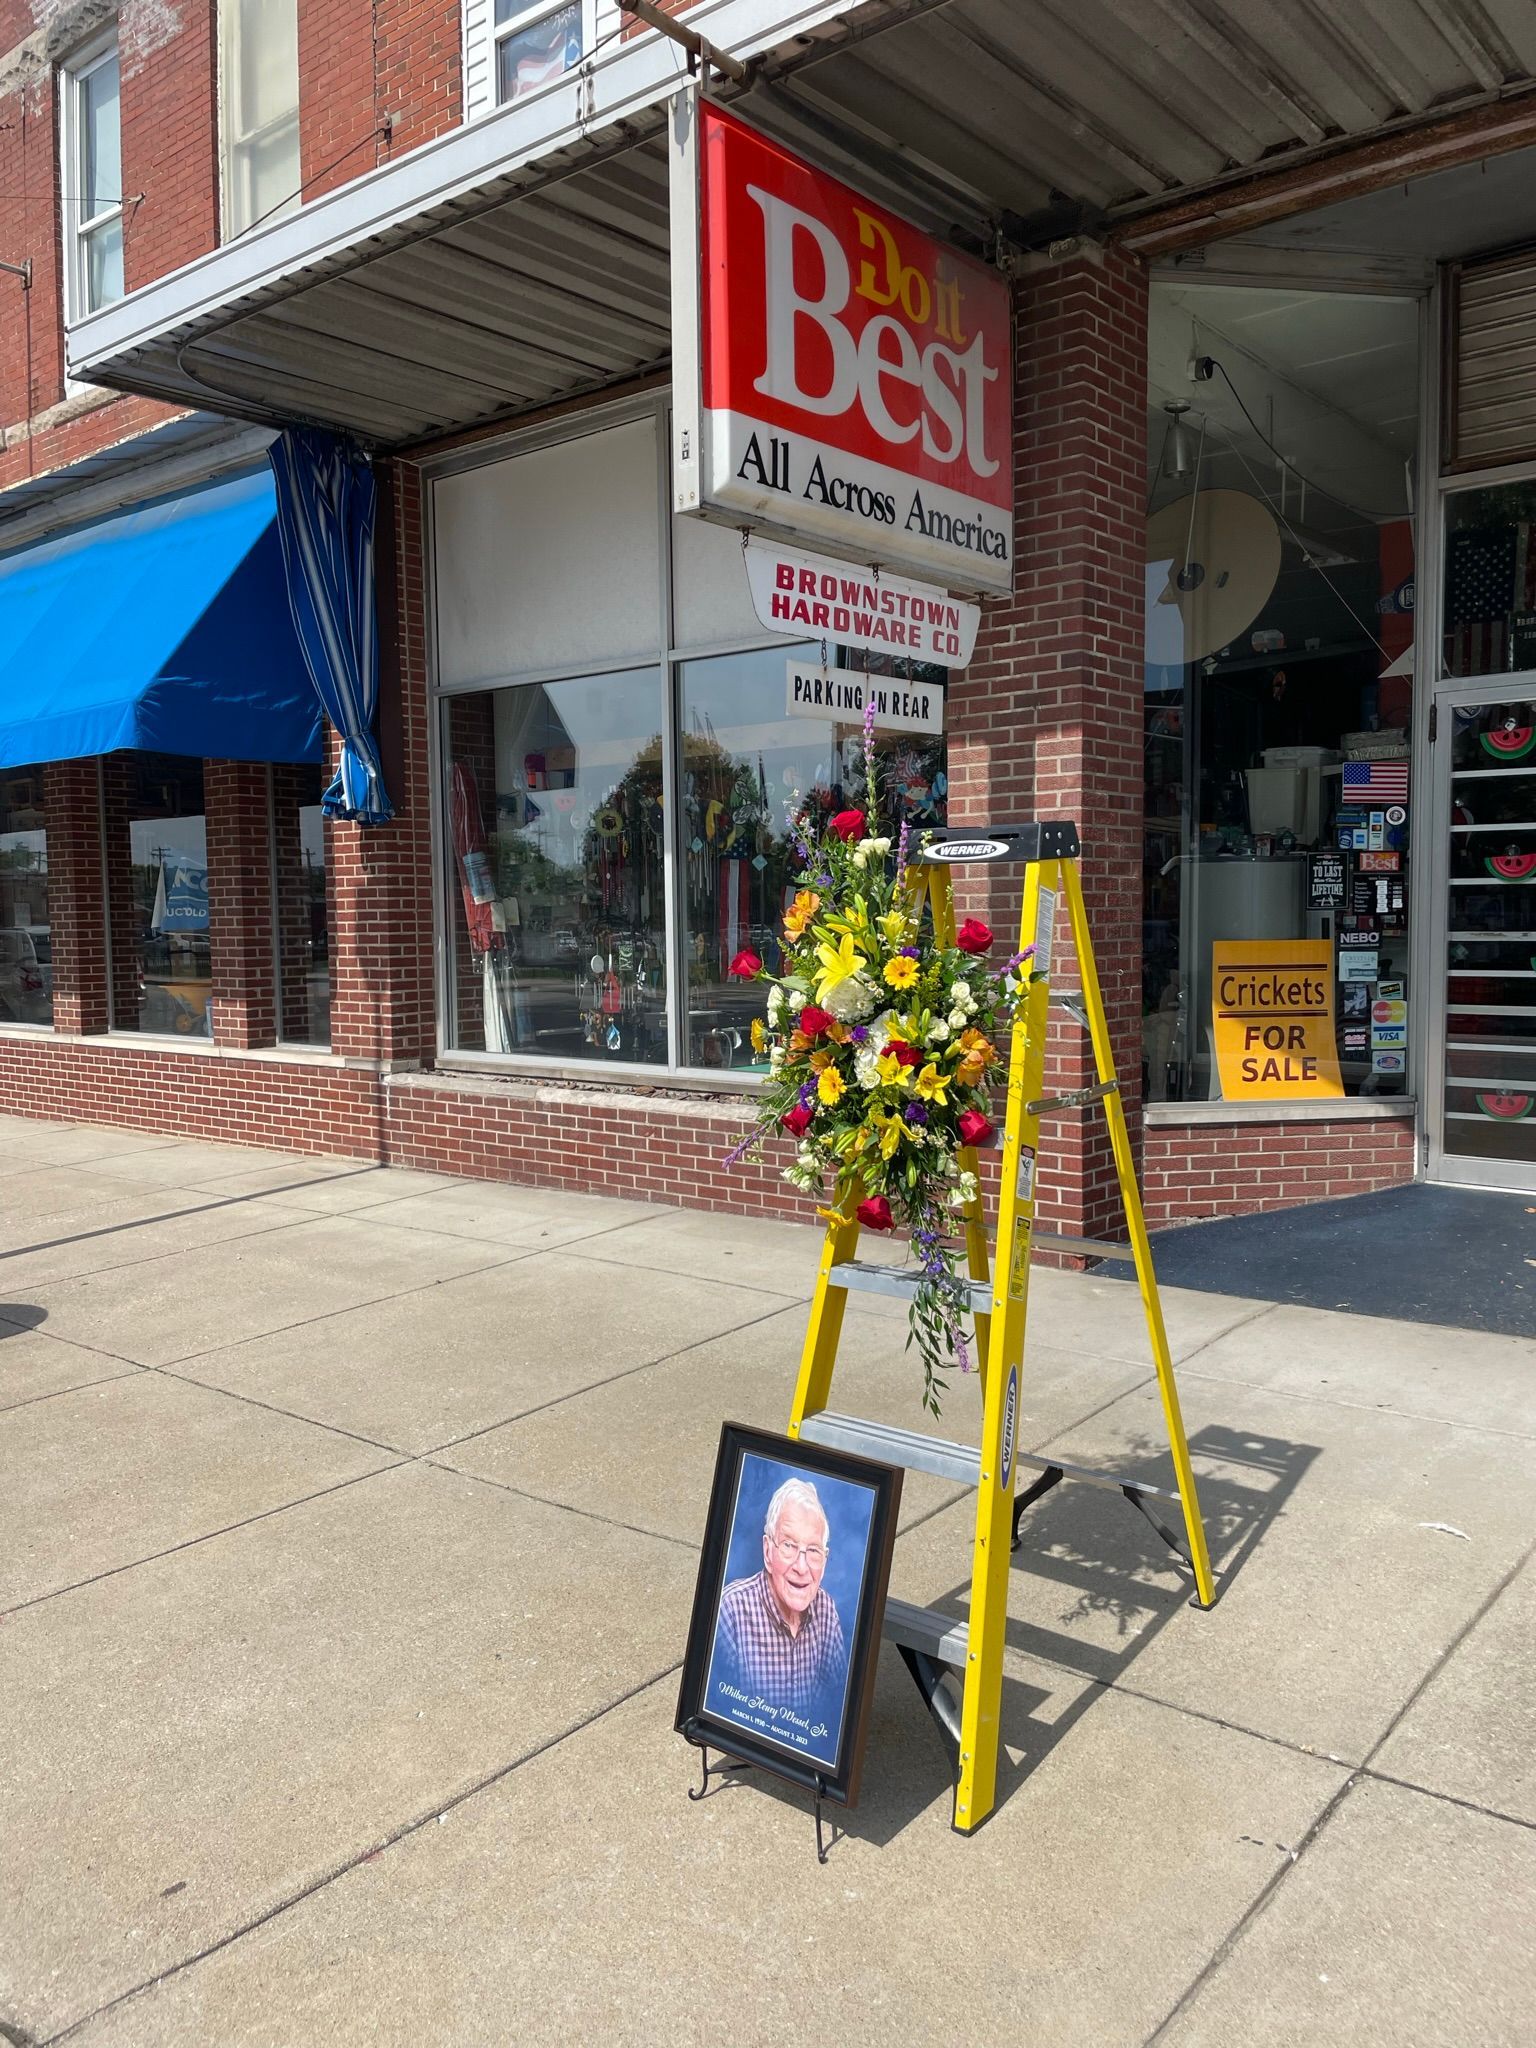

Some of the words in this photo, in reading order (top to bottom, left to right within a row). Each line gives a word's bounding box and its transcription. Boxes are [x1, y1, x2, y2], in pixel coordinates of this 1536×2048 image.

[852, 206, 931, 325] Do
[933, 256, 967, 345] it
[746, 183, 1000, 478] Best
[736, 431, 792, 494] All
[802, 453, 896, 525] Across
[904, 488, 1008, 561] America
[775, 563, 960, 631] BROWNSTOWN
[771, 593, 922, 649] HARDWARE
[932, 629, 963, 658] CO.
[793, 675, 863, 711] PARKING
[892, 690, 930, 720] REAR
[939, 844, 992, 856] WERNER
[1360, 852, 1398, 870] Best
[1312, 865, 1323, 877] TO
[1324, 865, 1343, 877] LAST
[1312, 883, 1344, 896] LIFETIME
[1340, 932, 1380, 944] NEBO
[1220, 974, 1326, 1007] Crickets
[1244, 1025, 1307, 1051] FOR
[1378, 1032, 1400, 1041] VISA
[1241, 1056, 1318, 1083] SALE
[1003, 1388, 1016, 1463] WERNER
[718, 1681, 749, 1703] Wilbert
[747, 1696, 779, 1719] Henry
[779, 1706, 810, 1731] Wessel,
[809, 1723, 828, 1738] Jr.
[731, 1708, 750, 1721] MARCH
[771, 1724, 790, 1738] AUGUST
